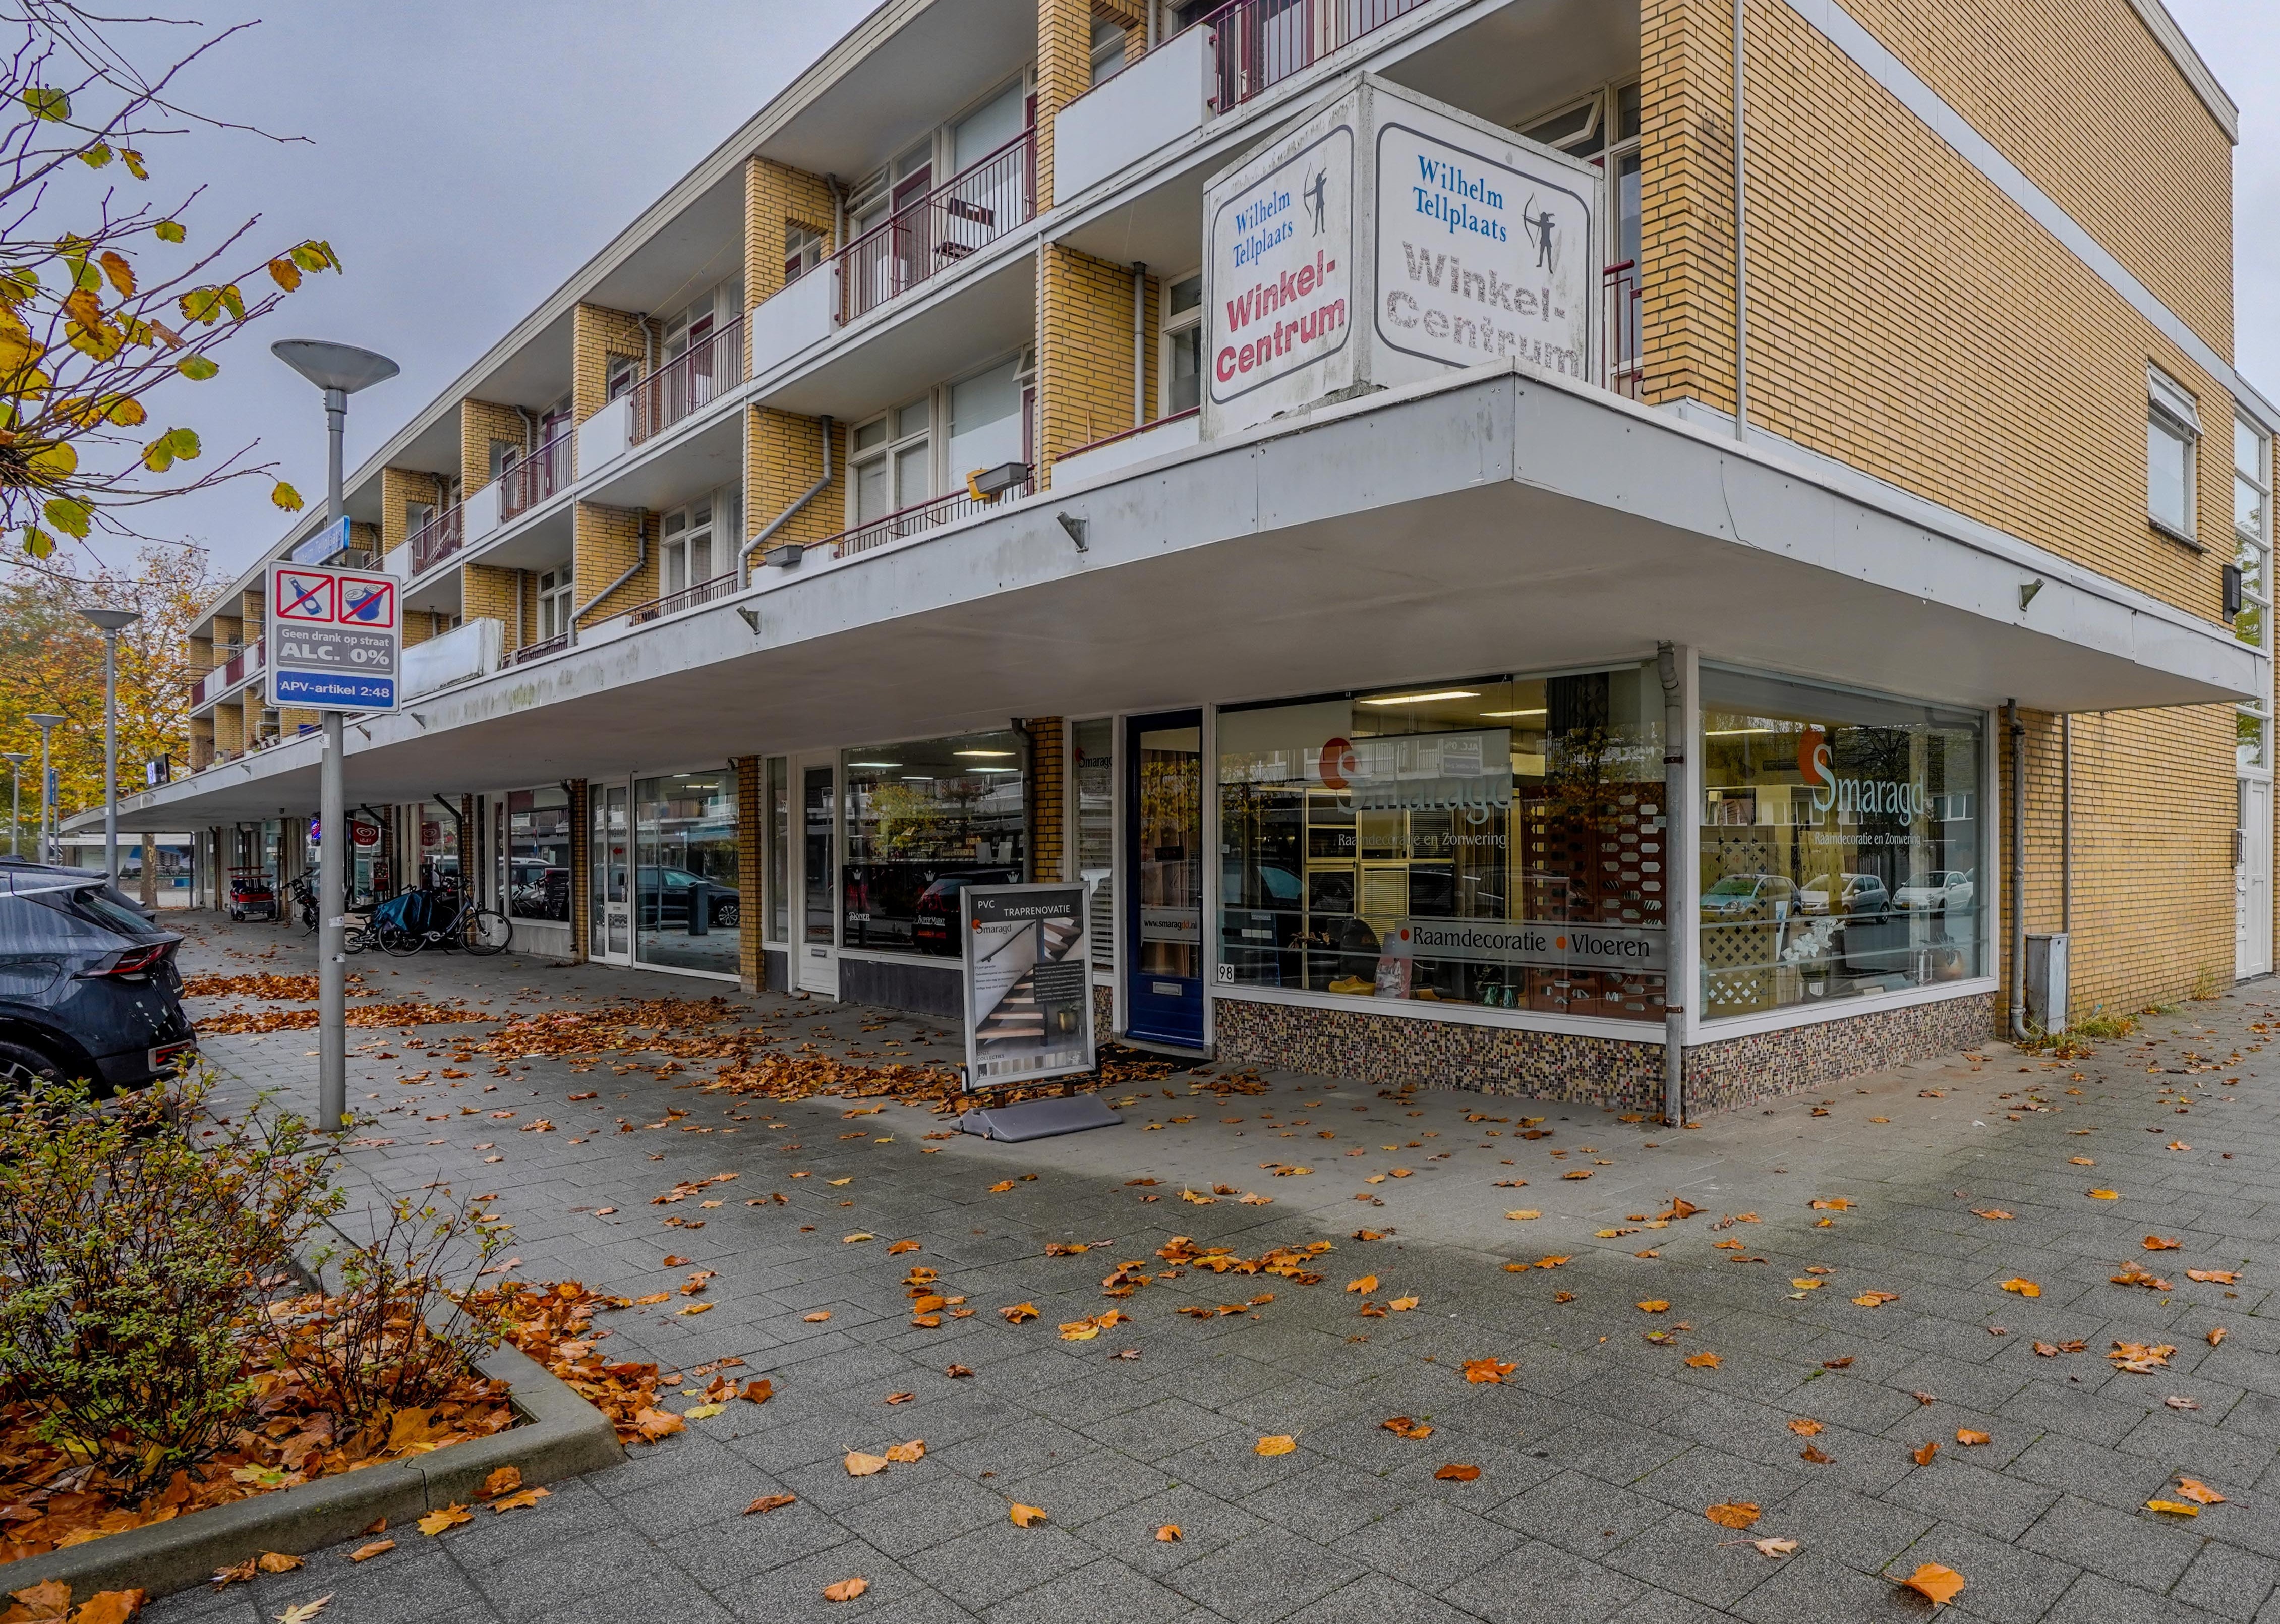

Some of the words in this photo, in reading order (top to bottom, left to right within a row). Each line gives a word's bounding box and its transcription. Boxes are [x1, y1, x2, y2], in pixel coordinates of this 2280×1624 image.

[1417, 154, 1503, 210] Wilhelm
[1236, 191, 1290, 235] Wilhelm
[1412, 186, 1506, 242] Tellplaats
[1233, 218, 1293, 268] Tellplaats
[1226, 249, 1335, 331] Winkel-
[1402, 240, 1566, 323] Winkel-
[1216, 298, 1344, 382] Centrum
[1386, 289, 1579, 377] Centrum
[281, 628, 309, 640] Geen
[311, 631, 341, 643] drank
[344, 636, 358, 646] op
[360, 636, 390, 647] straat
[280, 642, 340, 661] ALC.
[350, 648, 390, 665] 0%
[280, 681, 355, 695] APV-artikel
[360, 687, 390, 698] 2:48
[1811, 743, 1925, 827] Smaragd
[1338, 832, 1421, 846] Raamdecoratie
[1423, 835, 1438, 846] en
[1442, 831, 1506, 849] Zonwering
[1815, 832, 1873, 845] Raamdecoratie
[1874, 835, 1884, 845] en
[1885, 832, 1921, 847] Zonwering
[977, 900, 995, 909] PVC
[1003, 905, 1070, 917] TRAPRENOVATIE
[976, 924, 1012, 935] Smaragd
[1144, 920, 1197, 931] www.smaragdd.nl
[1412, 926, 1546, 951] Raamdecoratie
[1570, 933, 1651, 957] Vloeren
[1219, 966, 1233, 980] 98
[976, 1054, 1005, 1062] COLLECTIES
